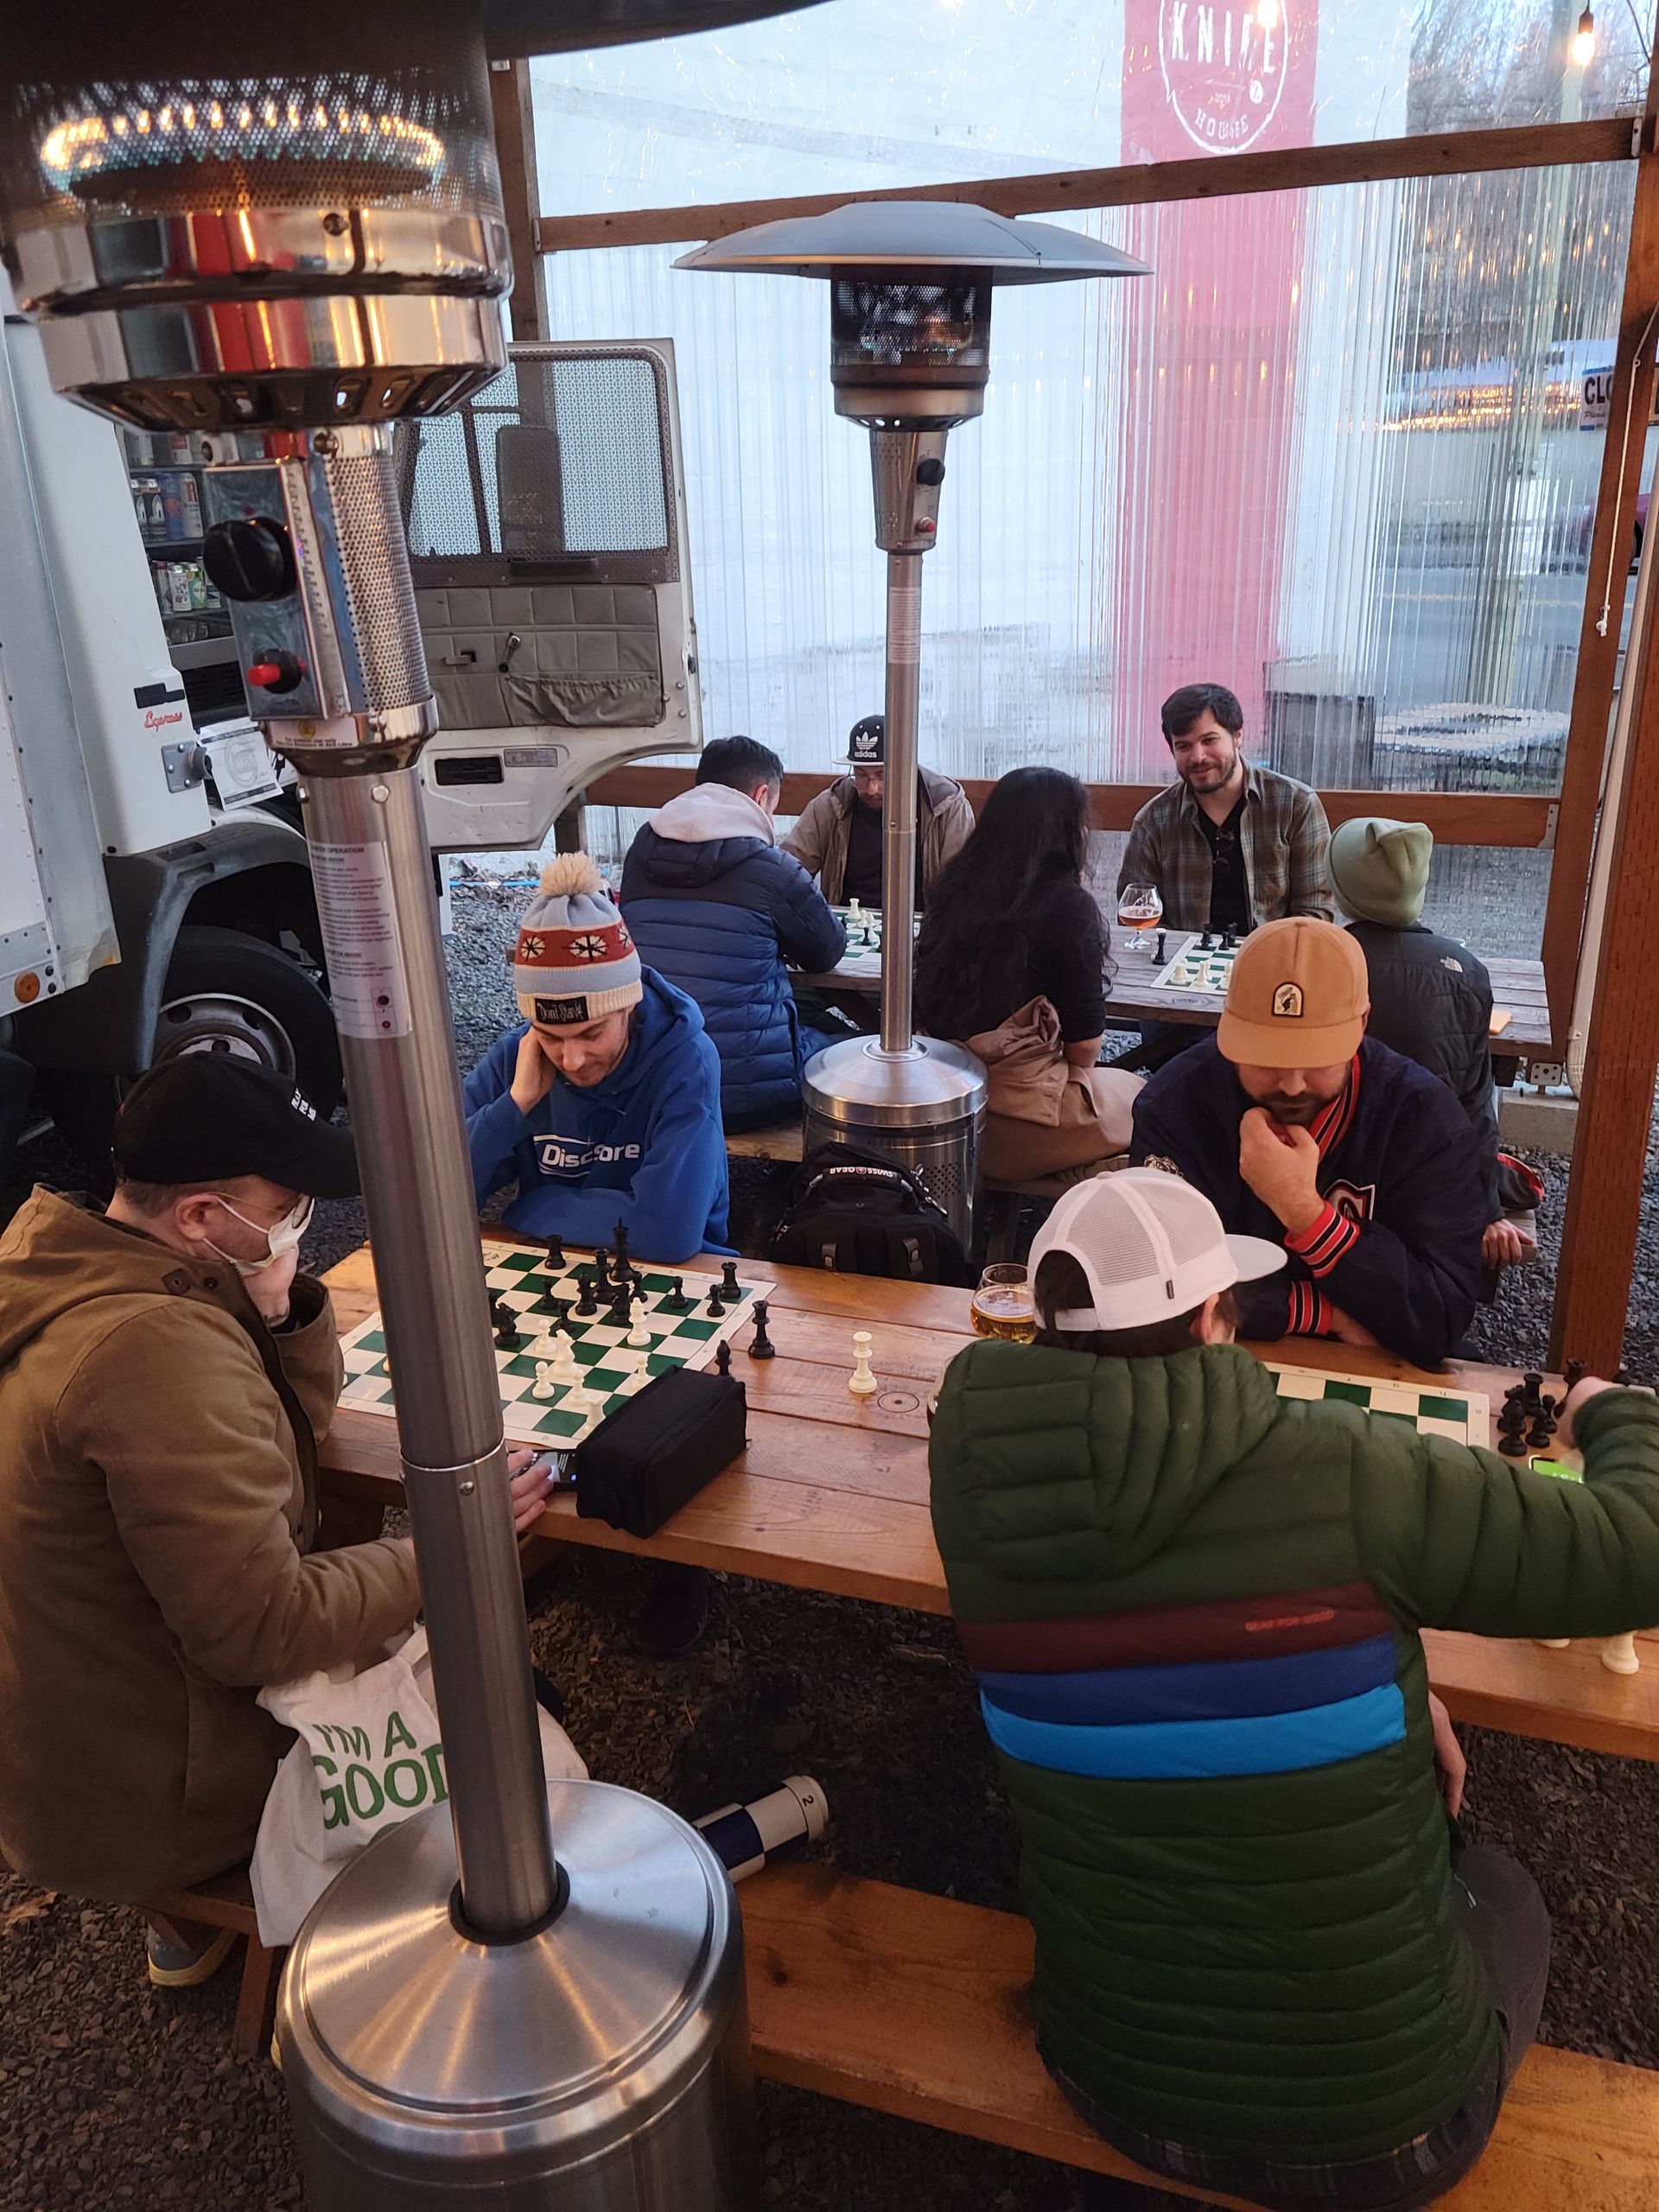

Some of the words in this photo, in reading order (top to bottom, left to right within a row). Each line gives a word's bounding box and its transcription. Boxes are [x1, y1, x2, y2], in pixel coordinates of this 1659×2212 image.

[143, 710, 183, 732] Express
[867, 1167, 893, 1178] SWISS
[384, 1710, 417, 1758] A
[802, 1795, 814, 1807] 2
